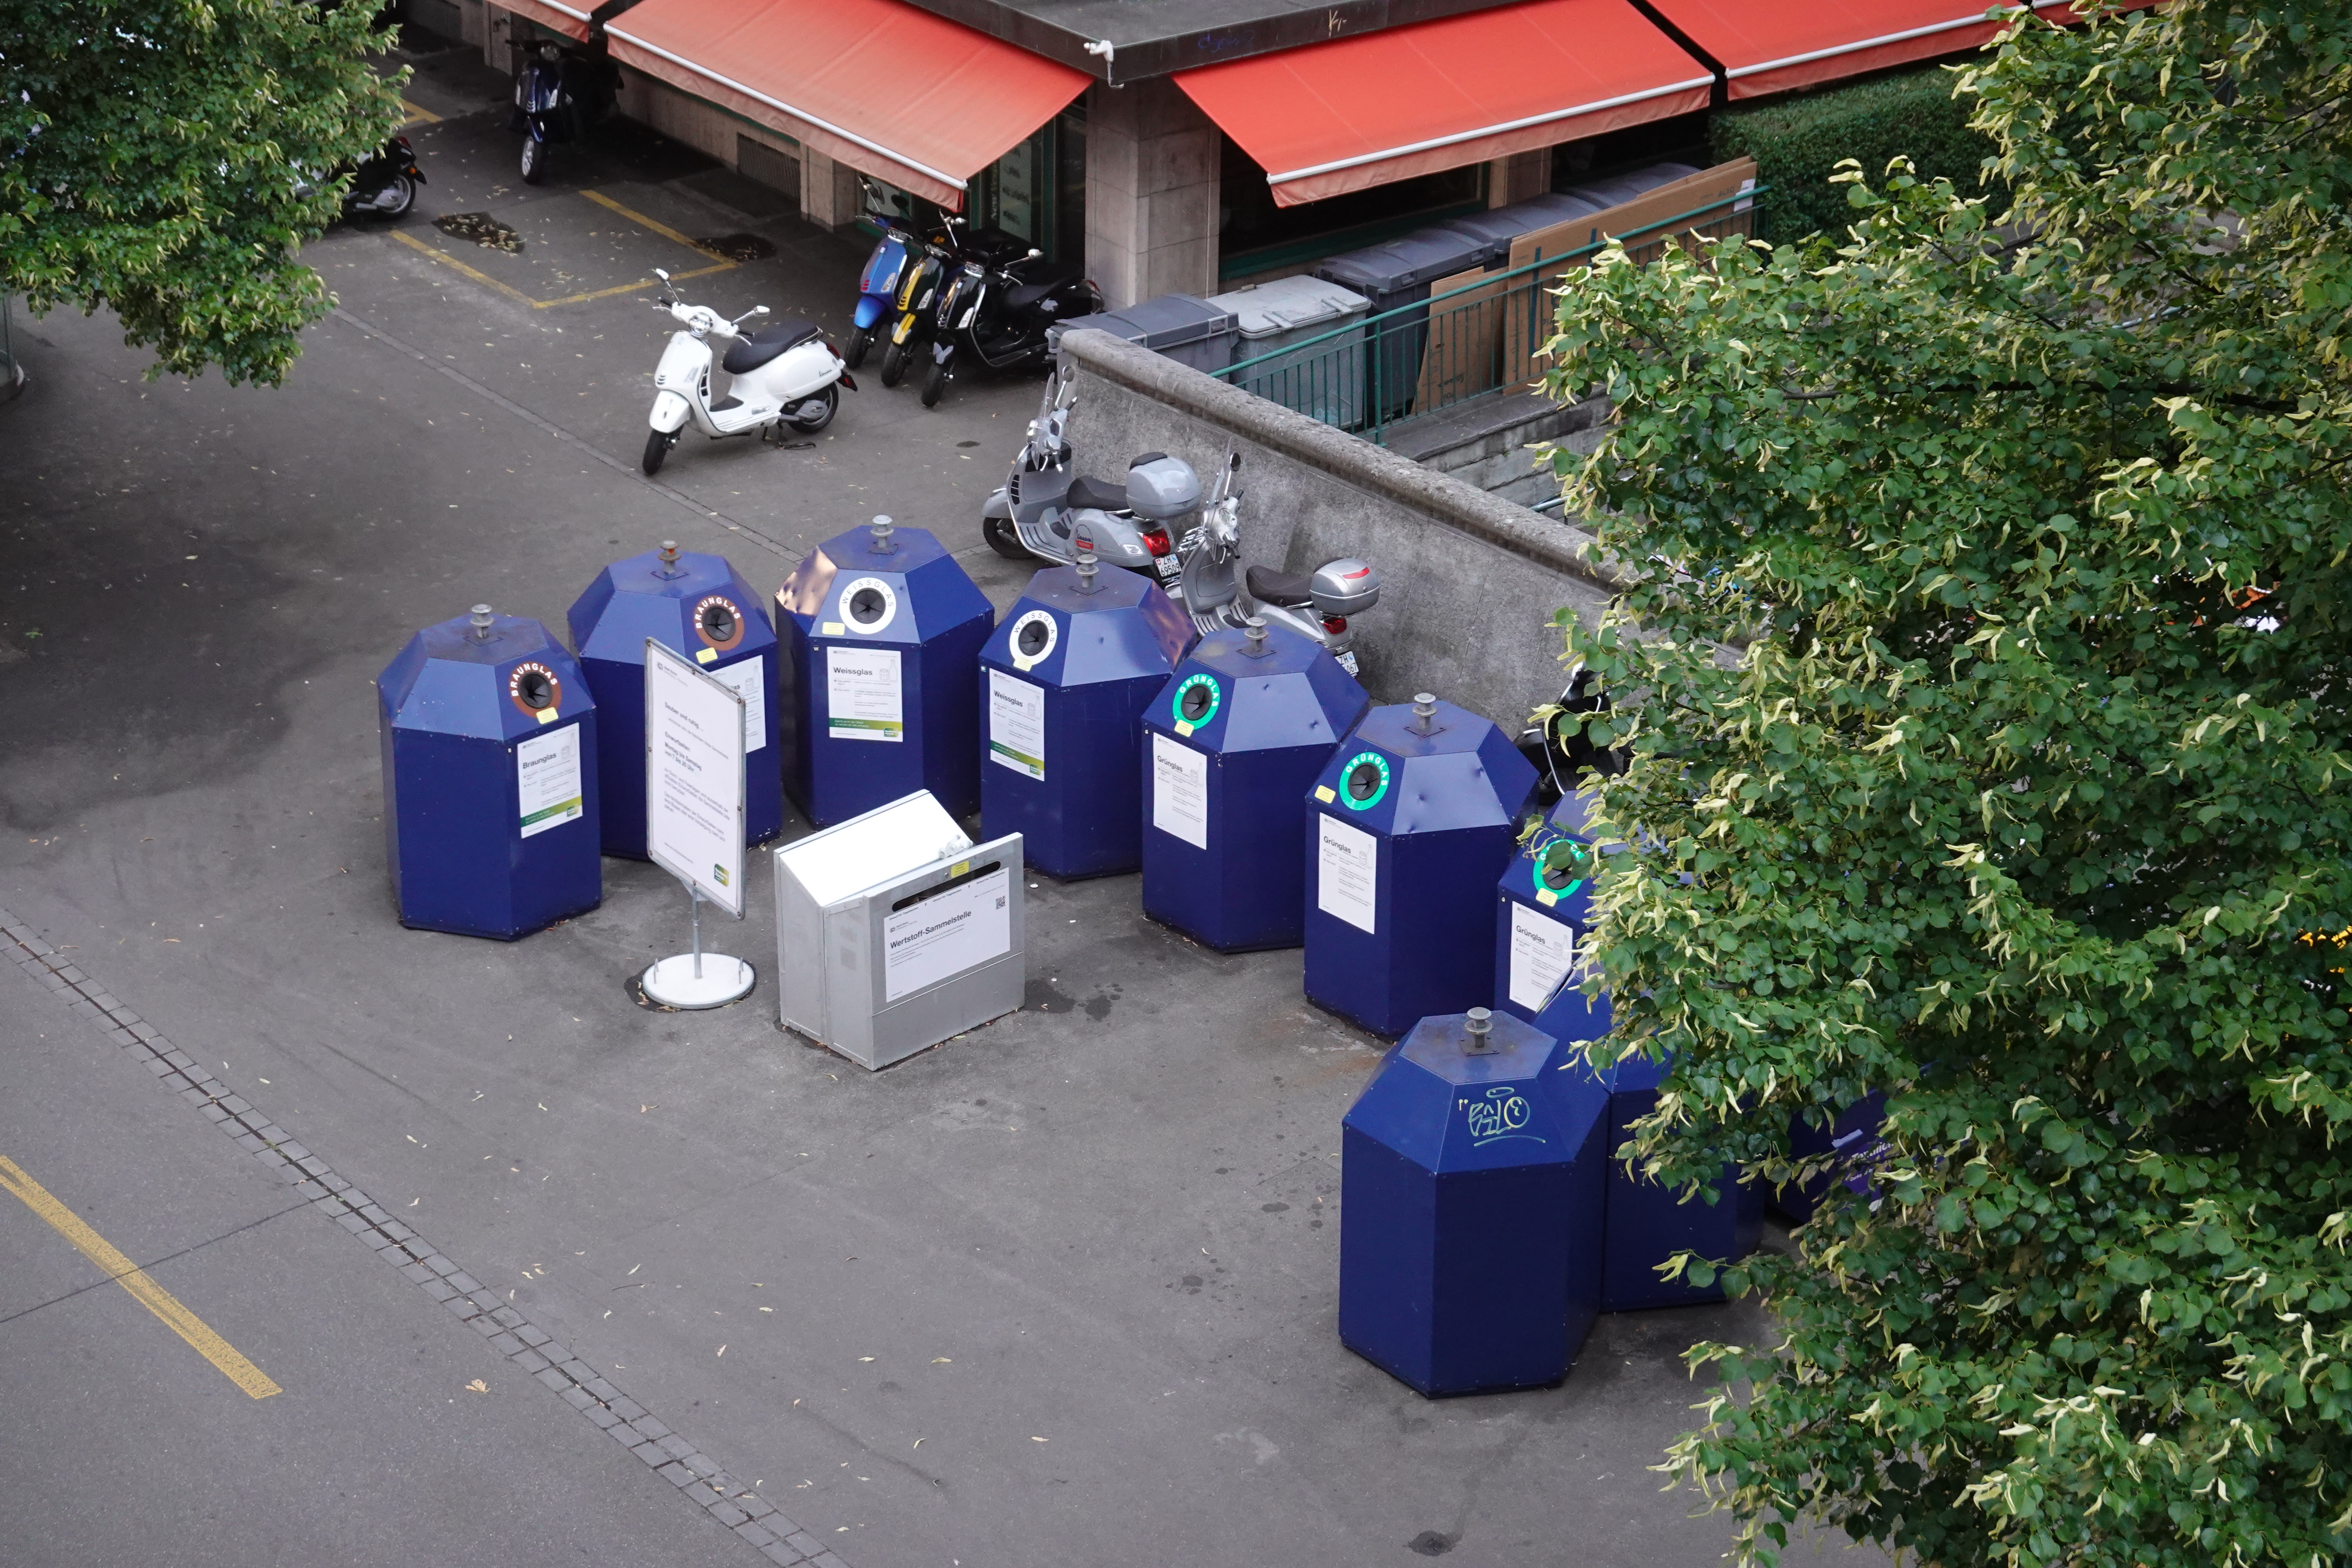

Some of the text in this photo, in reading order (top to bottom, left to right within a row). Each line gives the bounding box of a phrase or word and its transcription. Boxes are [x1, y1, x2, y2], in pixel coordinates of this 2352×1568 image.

[1161, 563, 1180, 576] 69509
[1164, 555, 1172, 565] ZH
[842, 579, 894, 607] WEISSGLAS
[695, 597, 741, 629] BRAUNGLAS
[1014, 612, 1055, 642] WEISSGLAS
[1339, 655, 1349, 665] ZH
[1344, 662, 1357, 673] 067
[511, 662, 558, 697] BRAUNGLAS
[833, 667, 873, 676] Weissglas
[994, 689, 1023, 707] Weissglas
[1179, 675, 1218, 707] GRÜNGLAS
[665, 701, 678, 714] Sauber
[688, 717, 698, 729] ruhig
[522, 752, 557, 769] Braunglas
[665, 741, 678, 755] Montag
[686, 755, 701, 771] Samstag
[1157, 755, 1183, 773] Grünglas
[1346, 753, 1387, 786] GRÜNGLAS
[1323, 835, 1352, 854] Grünglas
[890, 911, 972, 949] Wertstoff-Sammelstelle
[1516, 925, 1546, 945] Grünglas
